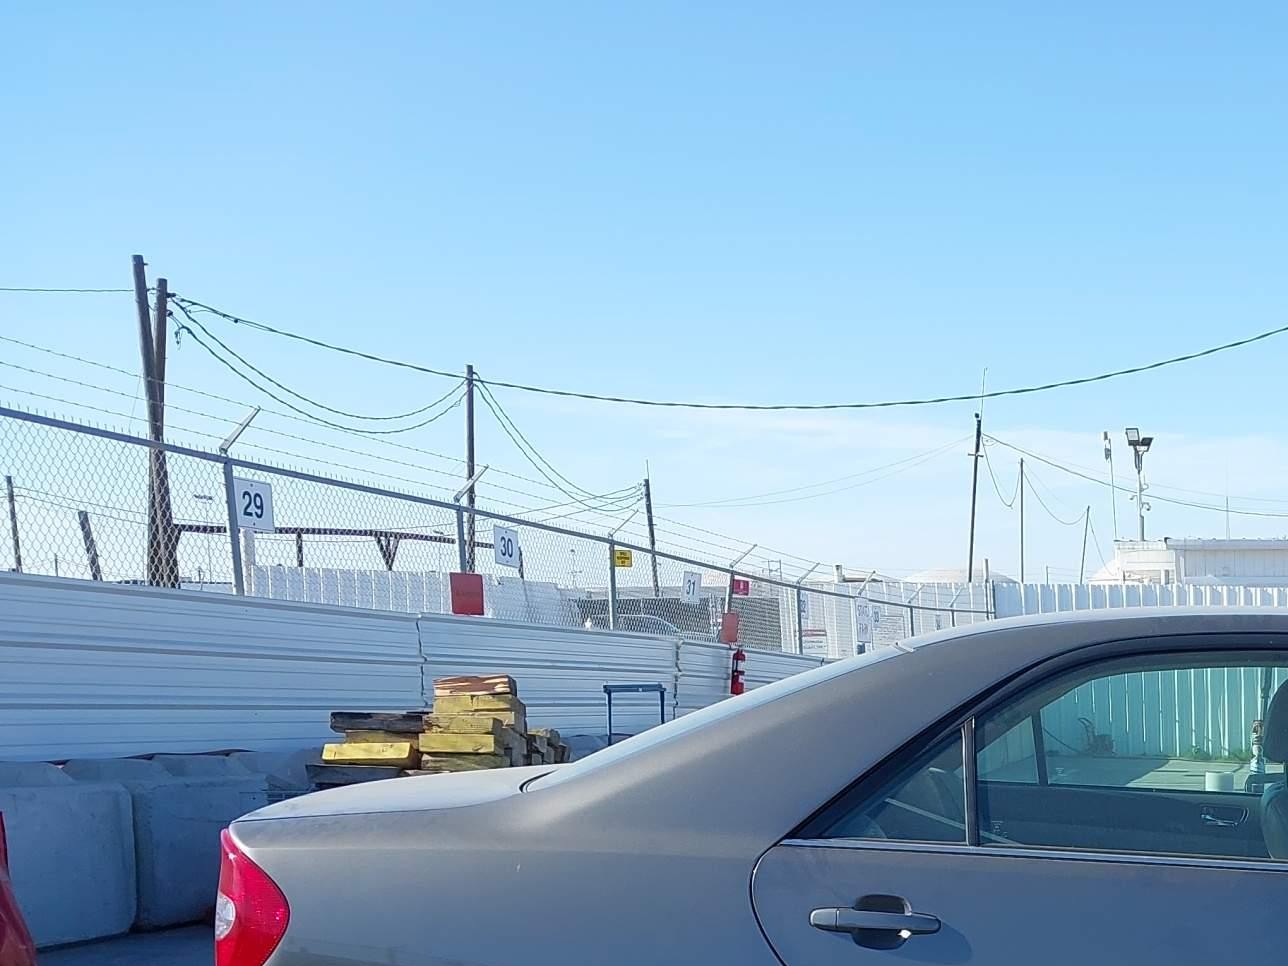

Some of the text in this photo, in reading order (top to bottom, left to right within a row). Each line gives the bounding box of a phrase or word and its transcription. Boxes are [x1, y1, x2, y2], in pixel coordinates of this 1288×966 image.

[242, 490, 264, 519] 29
[500, 535, 514, 558] 30
[686, 579, 696, 596] 31
